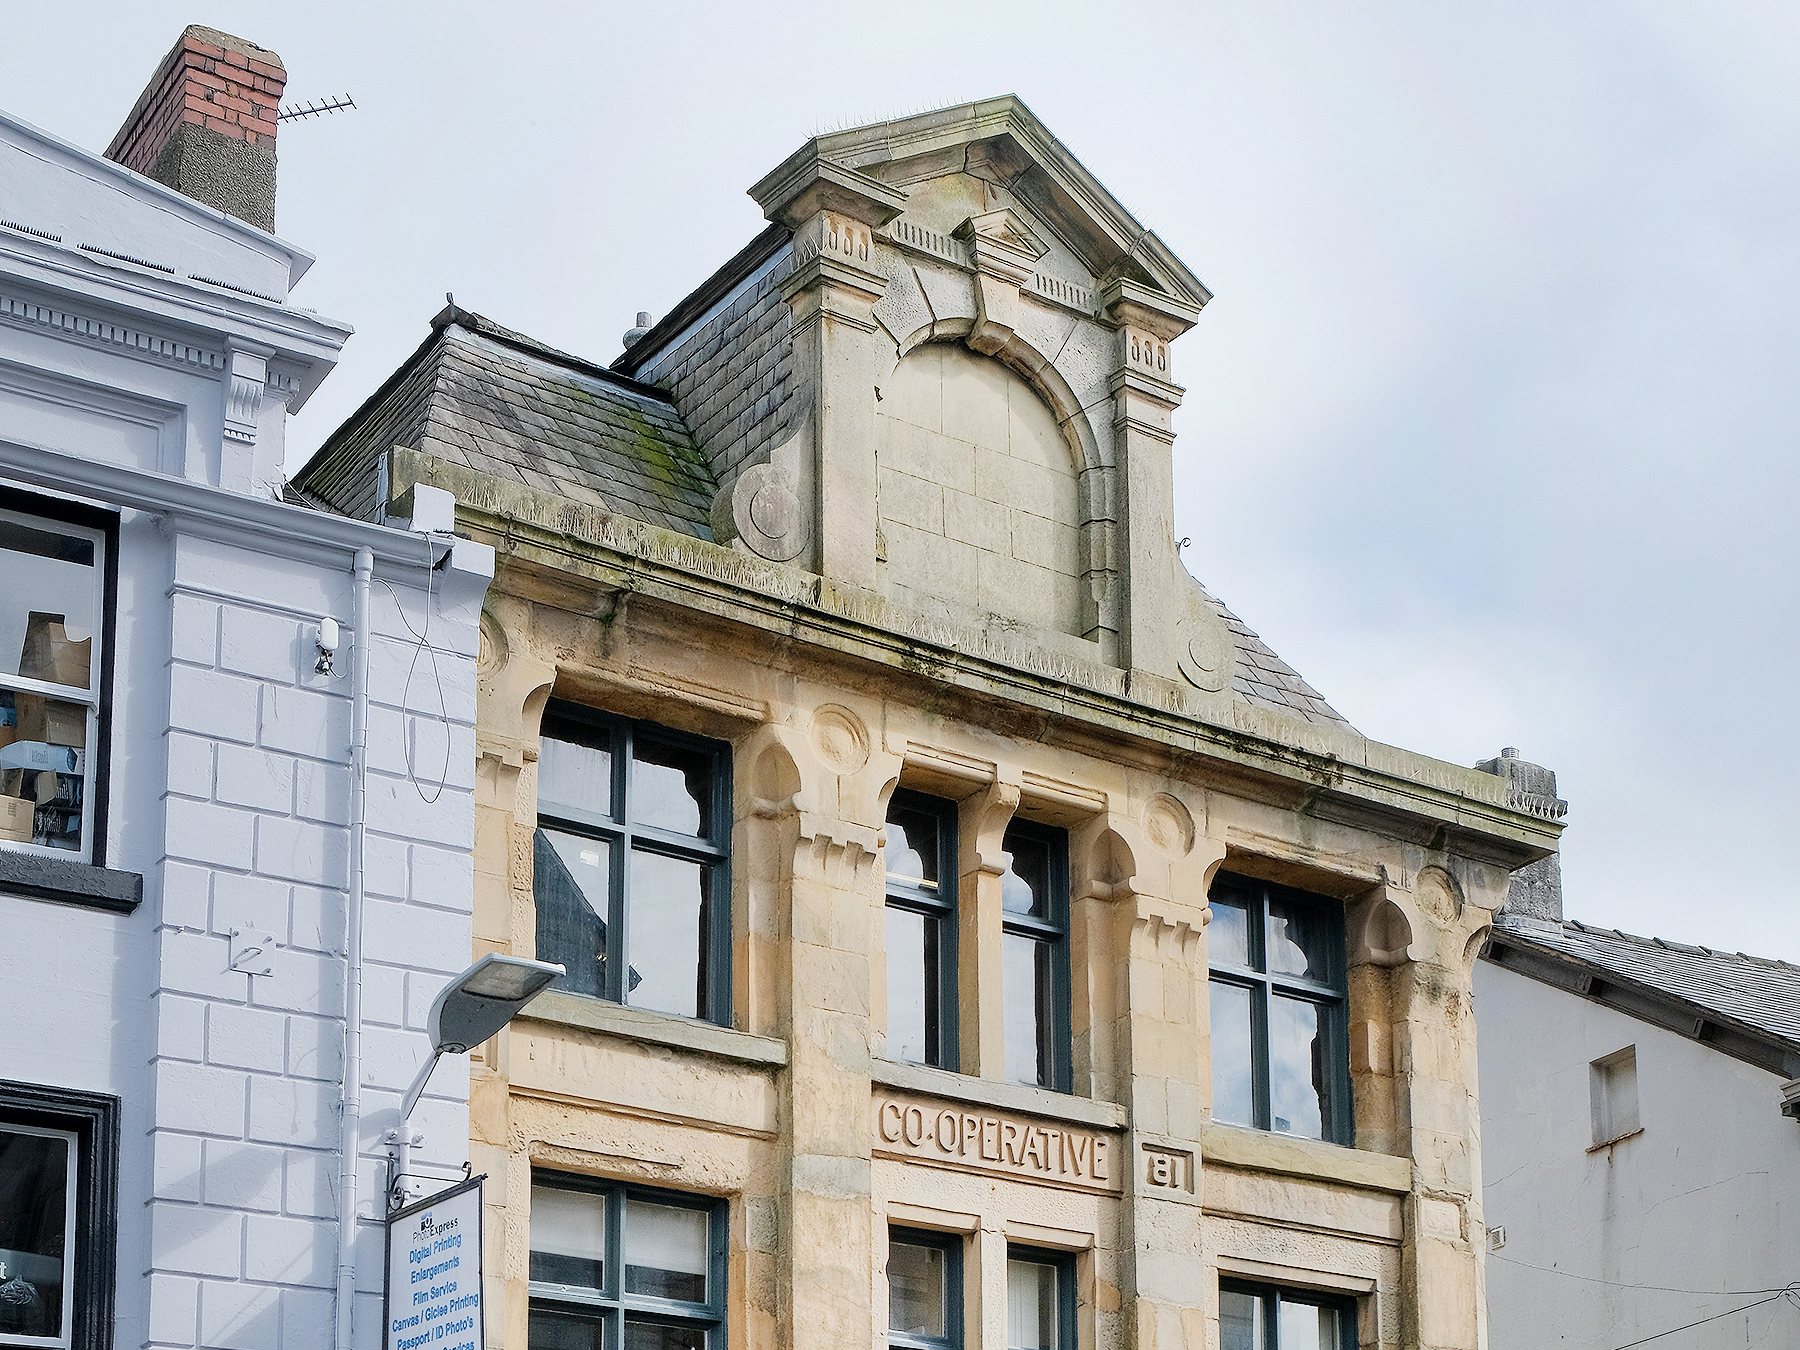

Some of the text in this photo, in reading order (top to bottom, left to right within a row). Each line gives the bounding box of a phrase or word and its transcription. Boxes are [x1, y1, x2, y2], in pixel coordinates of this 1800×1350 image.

[410, 1234, 462, 1264] Digital Printing
[411, 1256, 460, 1284] Enlargements
[413, 1281, 457, 1306] Film Service
[392, 1315, 419, 1332] Canvas
[425, 1304, 448, 1321] Giclee
[449, 1293, 479, 1313] Printing
[435, 1325, 444, 1340] ID
[445, 1316, 474, 1336] Photo's
